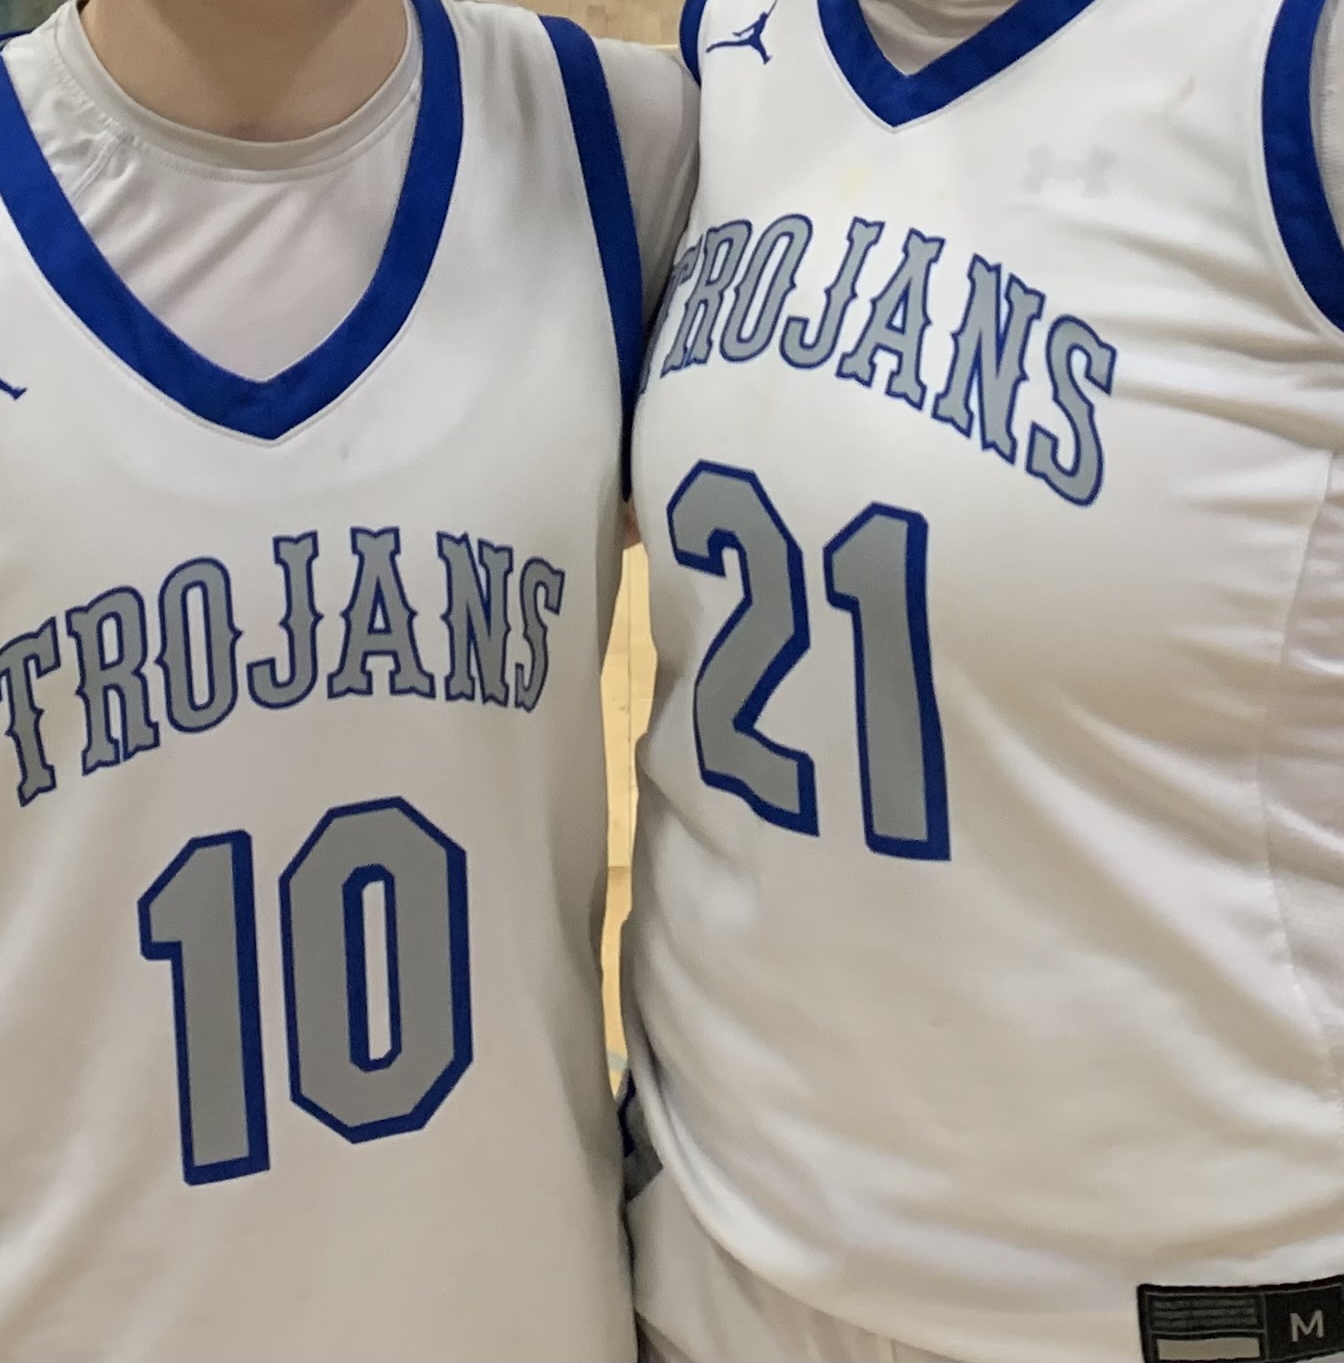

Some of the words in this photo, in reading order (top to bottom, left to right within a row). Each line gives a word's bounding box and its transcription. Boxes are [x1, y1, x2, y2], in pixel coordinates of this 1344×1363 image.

[666, 459, 952, 862] 21
[137, 796, 474, 1186] 10
[1289, 1309, 1324, 1343] M
